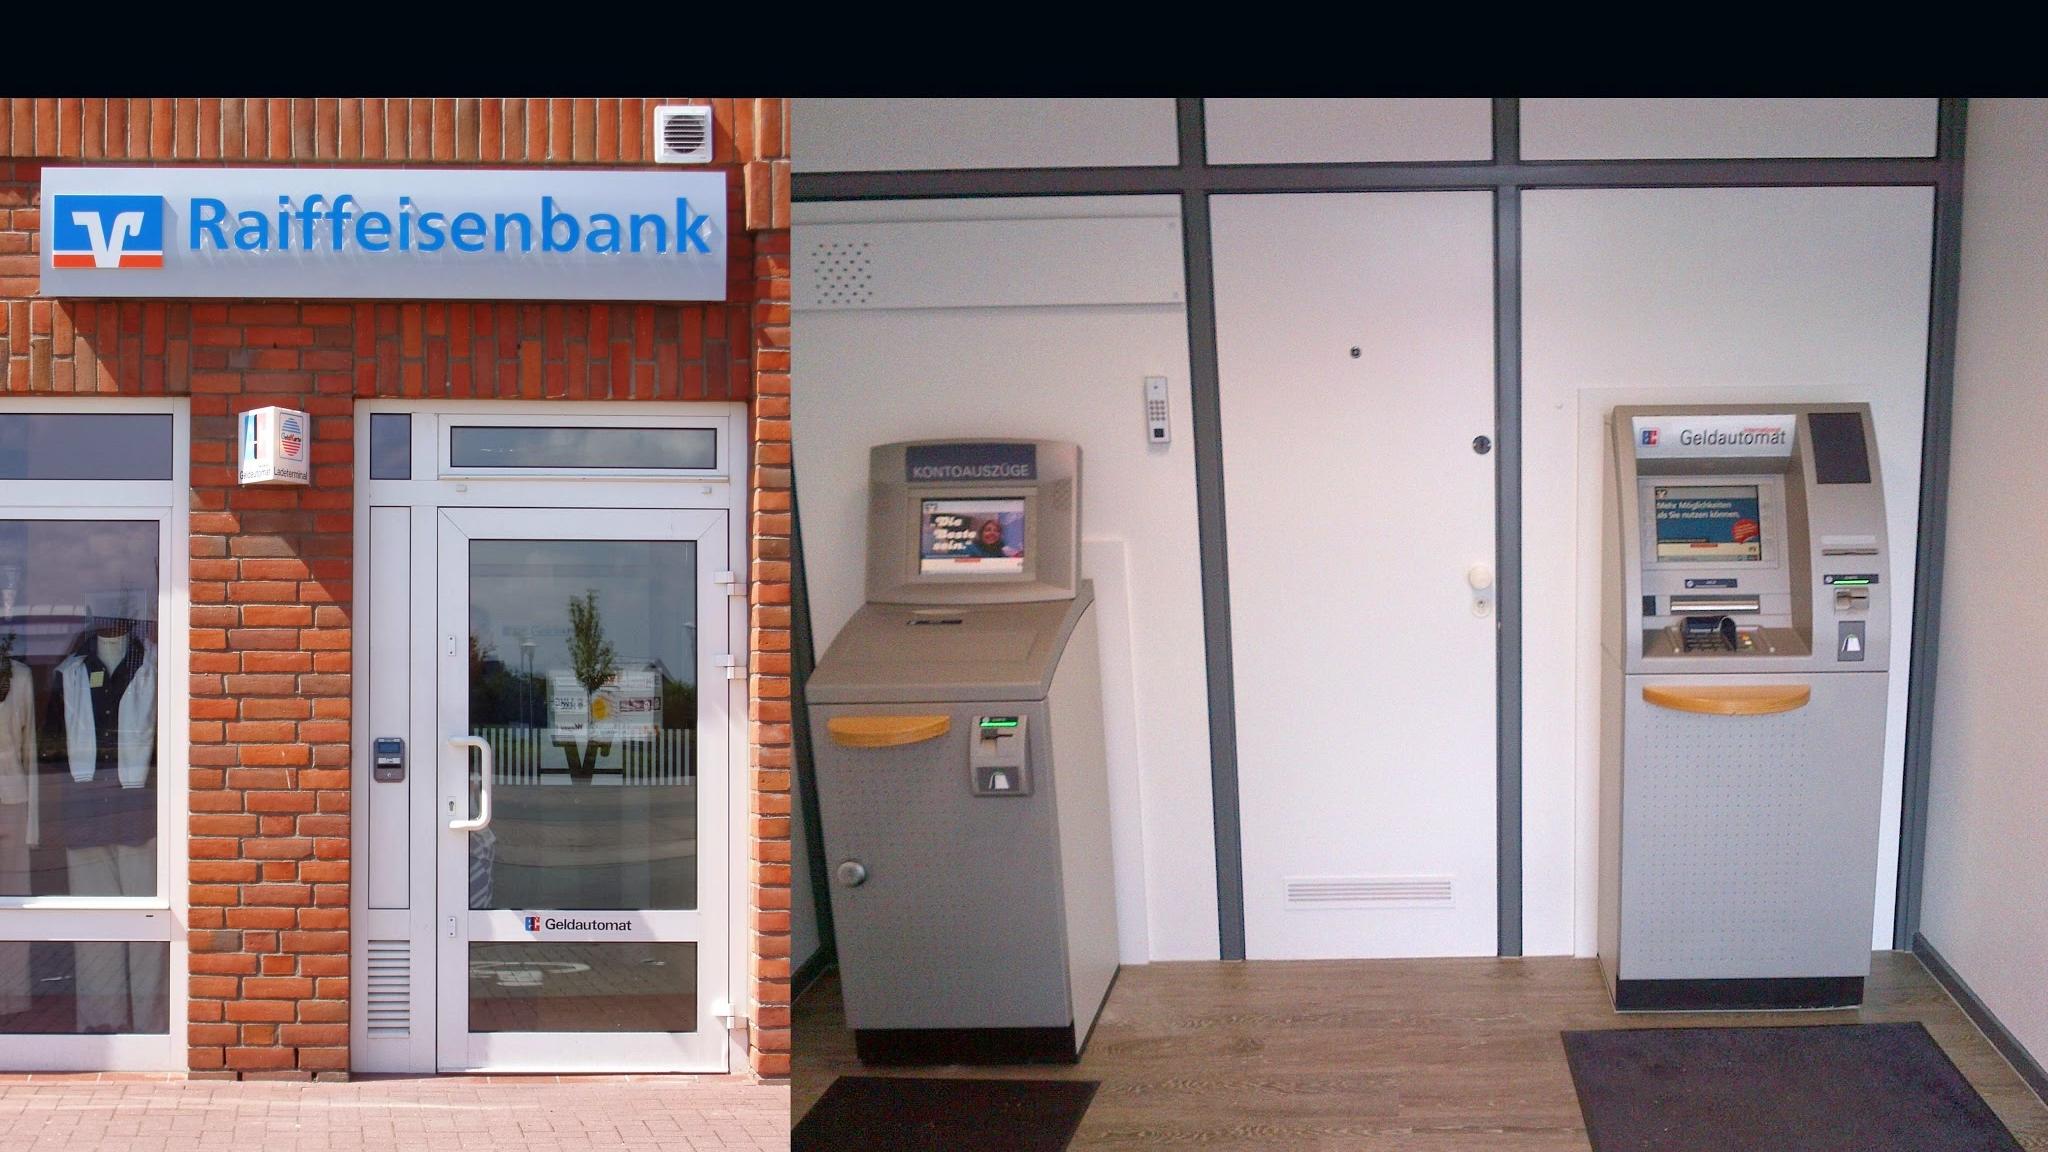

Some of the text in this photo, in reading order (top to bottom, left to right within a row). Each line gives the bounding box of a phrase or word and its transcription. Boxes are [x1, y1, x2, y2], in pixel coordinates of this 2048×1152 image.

[190, 194, 713, 255] Raiffeisenbank
[1680, 429, 1786, 446] Geldautomat
[274, 467, 308, 480] Ladeterminal
[912, 462, 1030, 479] KONTOAUSZÜGE
[1657, 501, 1732, 511] Mehr Möglichkeiten
[1668, 511, 1680, 519] Sie
[1709, 511, 1740, 519] können.
[545, 918, 632, 931] Geldautomat
